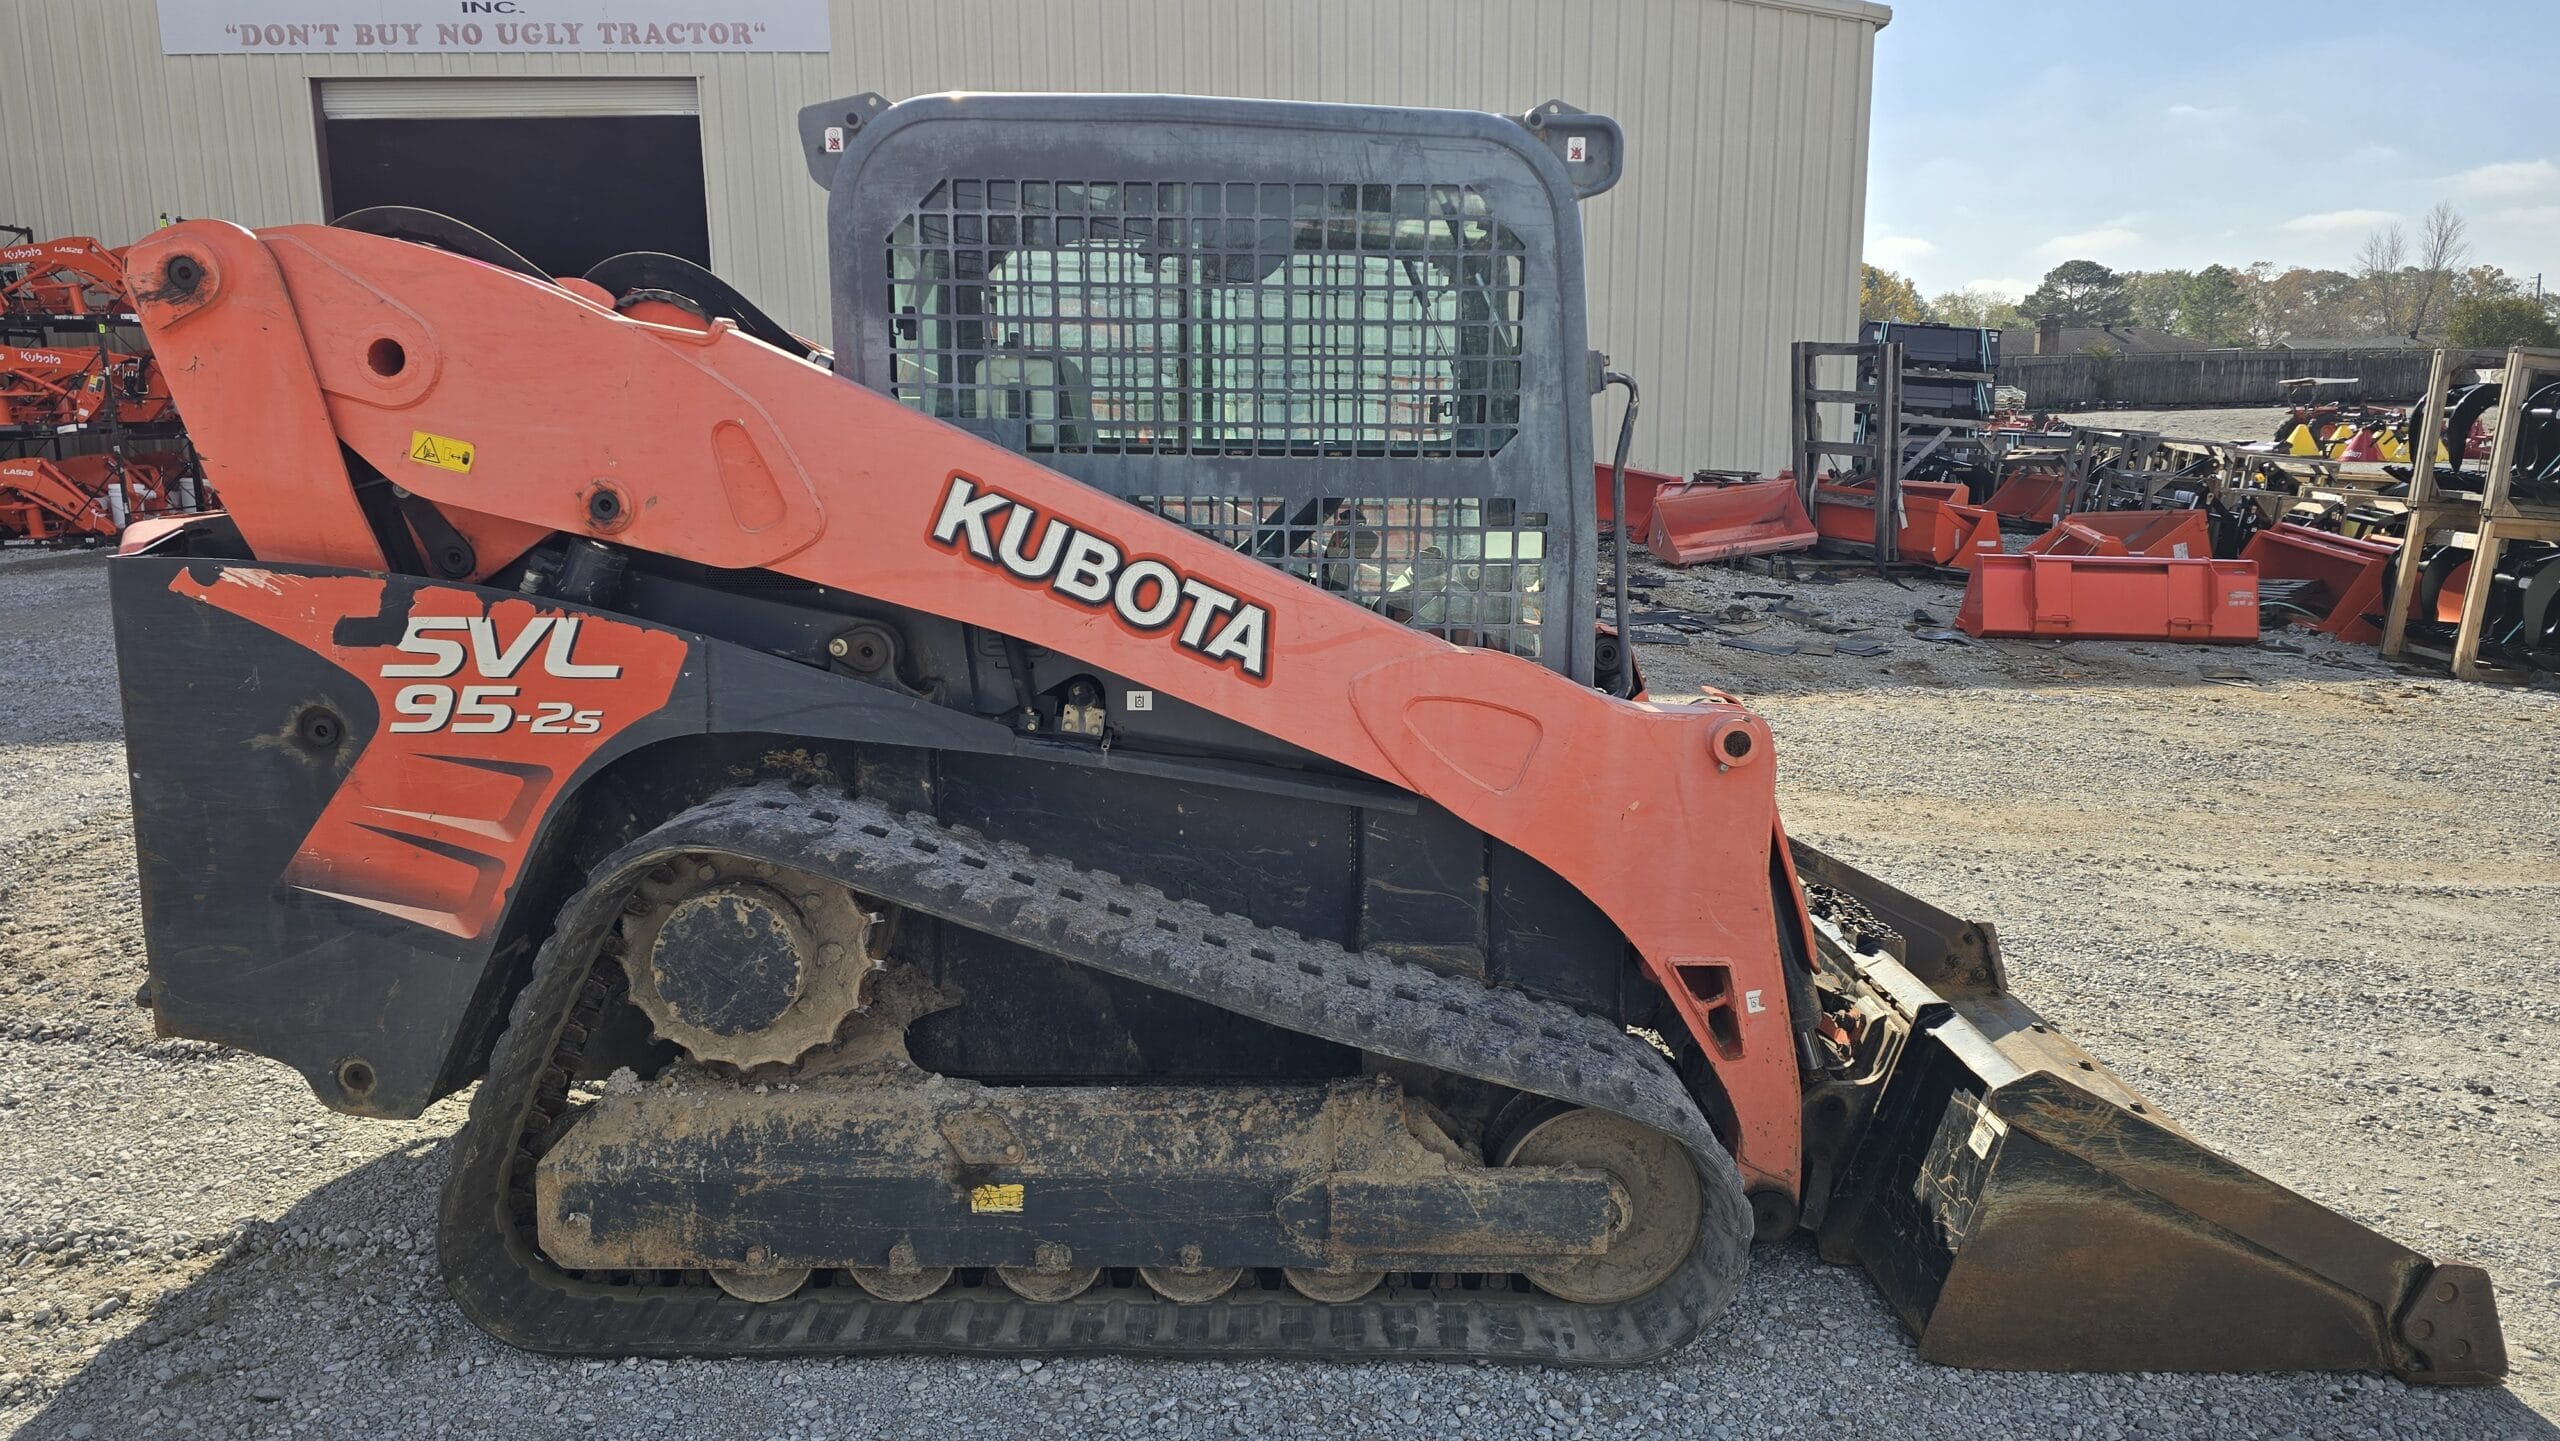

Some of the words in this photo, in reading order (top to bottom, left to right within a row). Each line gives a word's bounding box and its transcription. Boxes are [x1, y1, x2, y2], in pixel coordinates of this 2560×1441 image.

[461, 1, 526, 13] INC.
[225, 23, 340, 46] "DON'T
[353, 23, 422, 46] BUY
[436, 23, 483, 45] NO
[495, 22, 584, 45] UGLY
[597, 22, 766, 45] TRACTOR"
[3, 247, 43, 260] Kubota
[20, 350, 61, 364] Kubota
[932, 476, 1267, 677] KUBOTA
[380, 616, 622, 678] SVL
